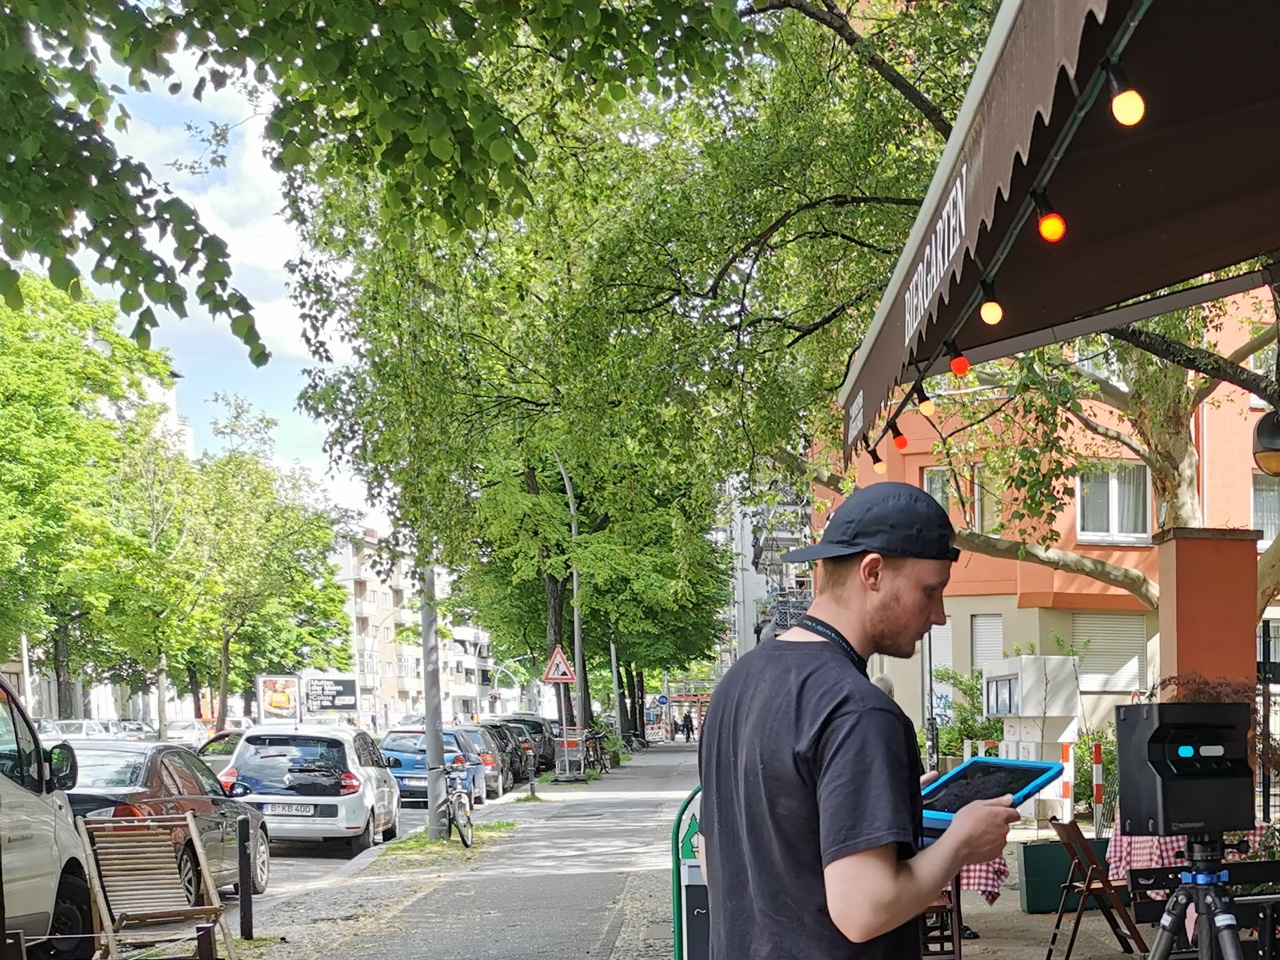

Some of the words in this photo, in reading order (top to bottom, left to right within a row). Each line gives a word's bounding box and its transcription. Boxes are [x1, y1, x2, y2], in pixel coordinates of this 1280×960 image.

[904, 163, 967, 348] BIERGARTEN
[270, 804, 277, 812] B
[282, 804, 293, 812] KB
[295, 805, 311, 813] 400
